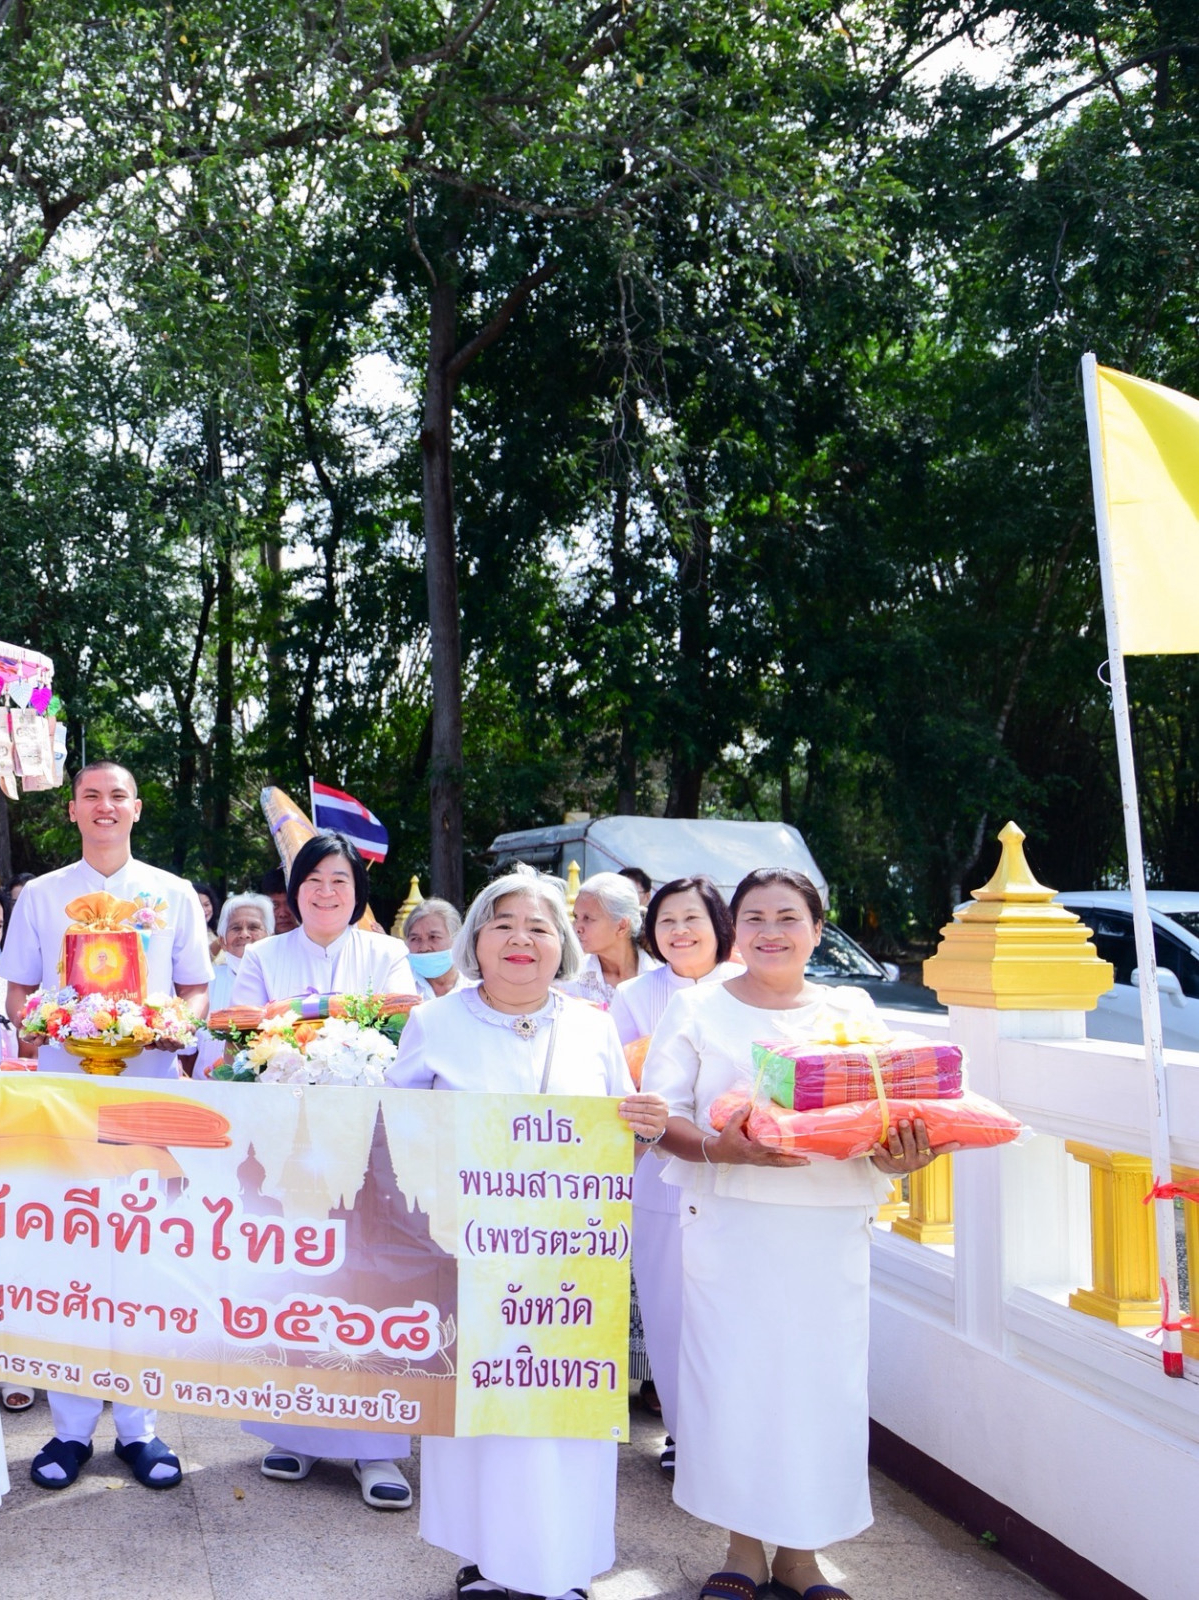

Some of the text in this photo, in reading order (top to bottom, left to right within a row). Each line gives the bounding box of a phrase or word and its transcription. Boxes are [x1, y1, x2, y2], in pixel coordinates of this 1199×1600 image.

[512, 1109, 582, 1144] ศปธ.
[459, 1169, 633, 1201] พนมสารคาม
[464, 1217, 630, 1260] (เพชรตะวัน)
[219, 1296, 431, 1352] ๒๕๖๘
[501, 1283, 593, 1326] จังหวัด
[471, 1345, 617, 1390] ฉะเชิงเทรา
[92, 1371, 131, 1394] ๘๑
[142, 1370, 162, 1397] ปี
[174, 1383, 418, 1421] หลวงพ่อธัมมชโย
